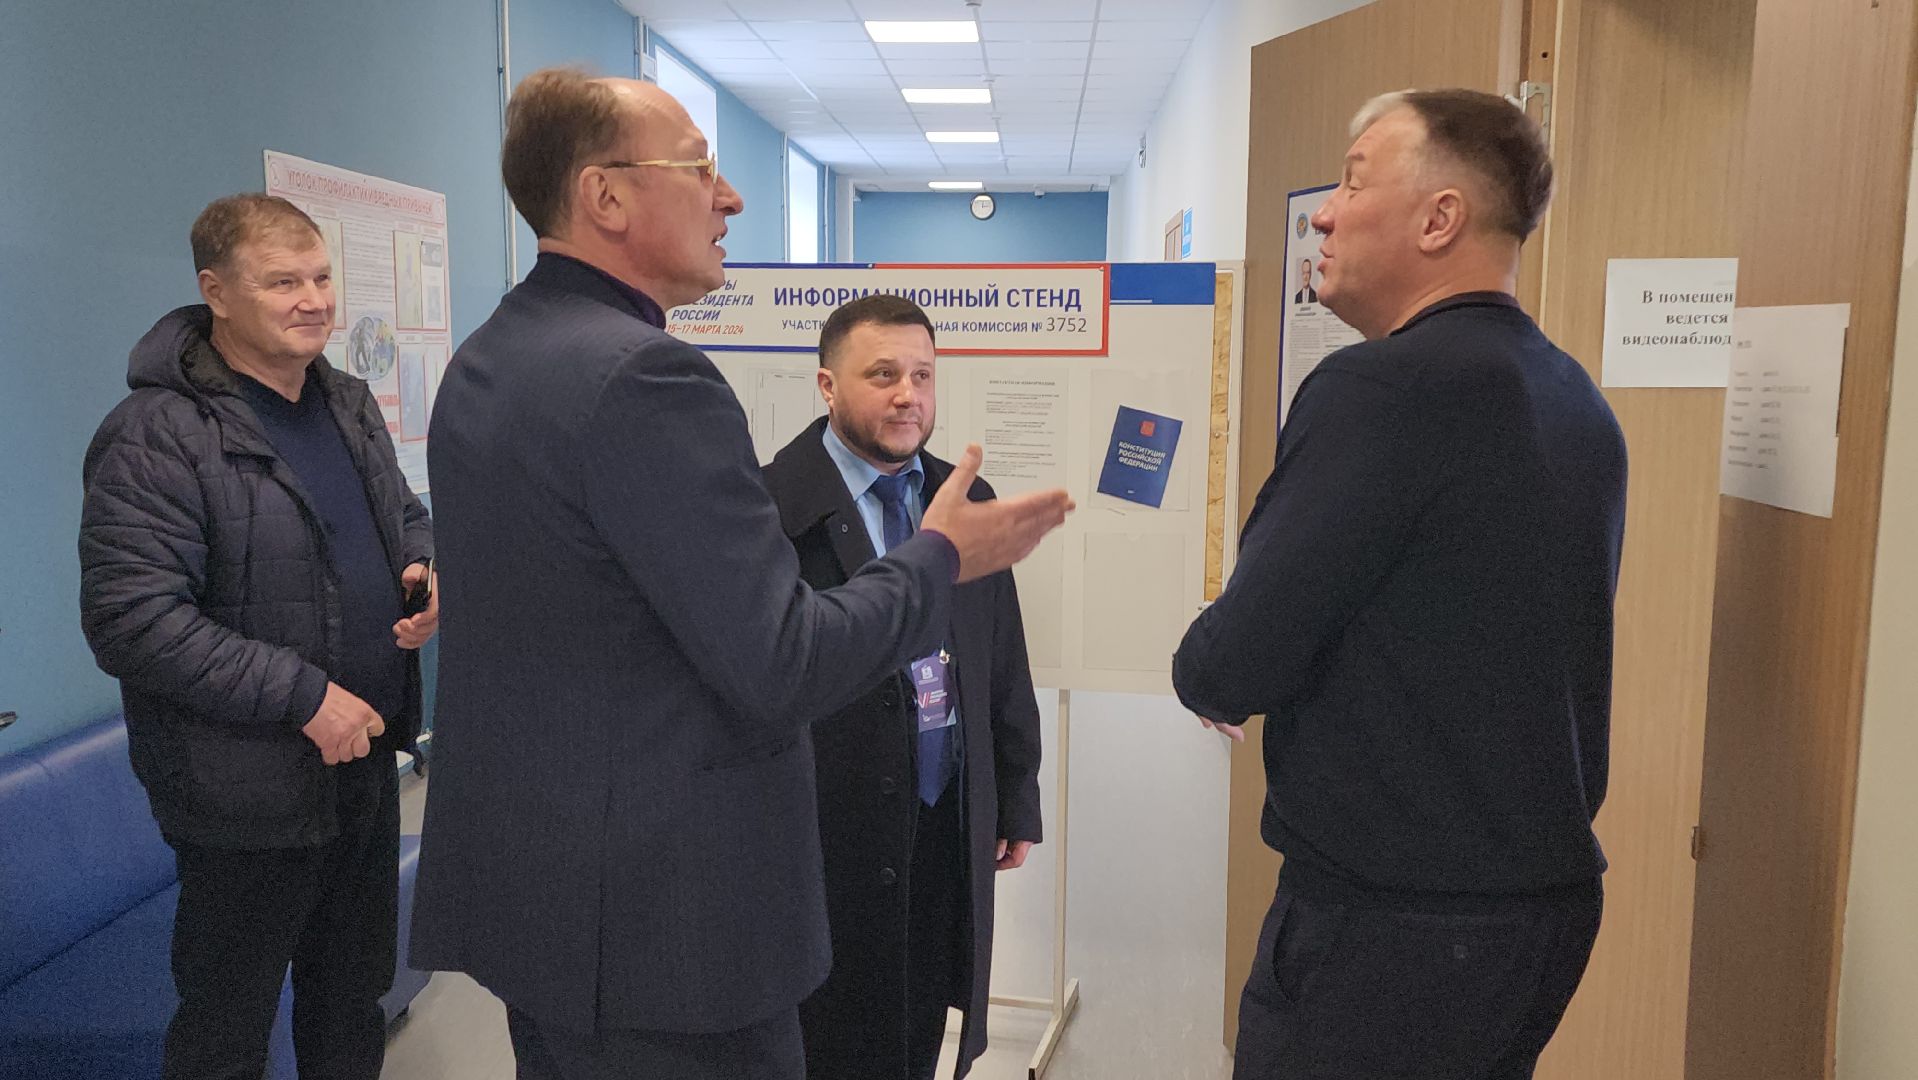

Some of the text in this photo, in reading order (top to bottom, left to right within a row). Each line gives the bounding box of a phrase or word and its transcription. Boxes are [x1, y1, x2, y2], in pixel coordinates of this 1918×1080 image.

[1006, 287, 1082, 312] СТЕНД
[1642, 290, 1653, 304] В
[671, 309, 721, 322] РОССИИ
[1666, 313, 1729, 325] ведется
[691, 324, 721, 335] МАРТА
[722, 324, 745, 335] 2024
[962, 320, 1028, 333] КОМИССИЯ
[1031, 321, 1043, 333] №
[1046, 316, 1087, 333] 3752
[1118, 448, 1162, 465] РОССИЙСКОЙ
[1118, 456, 1158, 472] ФЕДЕРАЦИИ
